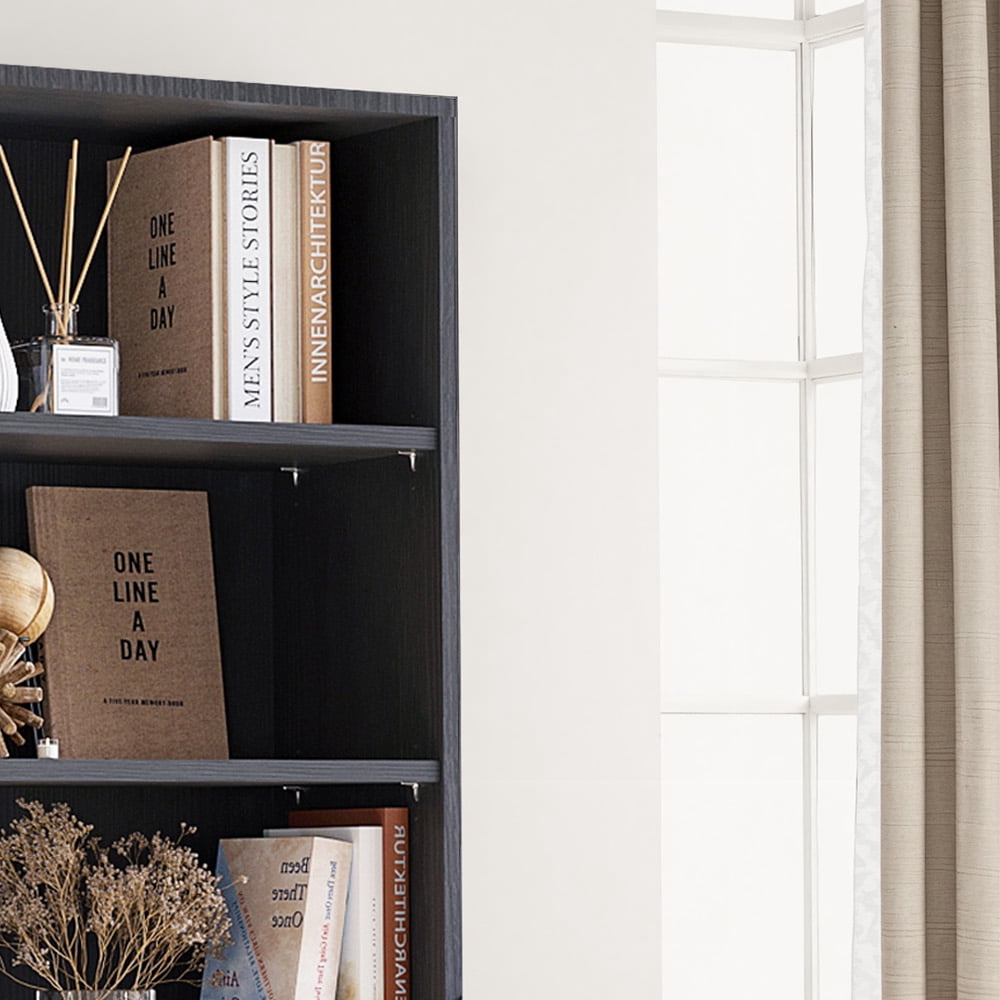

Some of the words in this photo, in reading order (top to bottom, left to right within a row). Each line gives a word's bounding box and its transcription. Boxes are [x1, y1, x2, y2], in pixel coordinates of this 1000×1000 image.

[241, 151, 258, 250] STORIES
[150, 212, 175, 239] ONE
[148, 243, 176, 270] LINE
[309, 142, 328, 382] INNENARCHITEKTUR
[158, 276, 166, 299] A
[243, 257, 260, 331] STYLE
[150, 306, 175, 330] DAY
[243, 337, 260, 408] MEN'S
[114, 552, 154, 574] ONE
[113, 581, 159, 603] LINE
[132, 610, 145, 632] A
[120, 639, 160, 661] DAY
